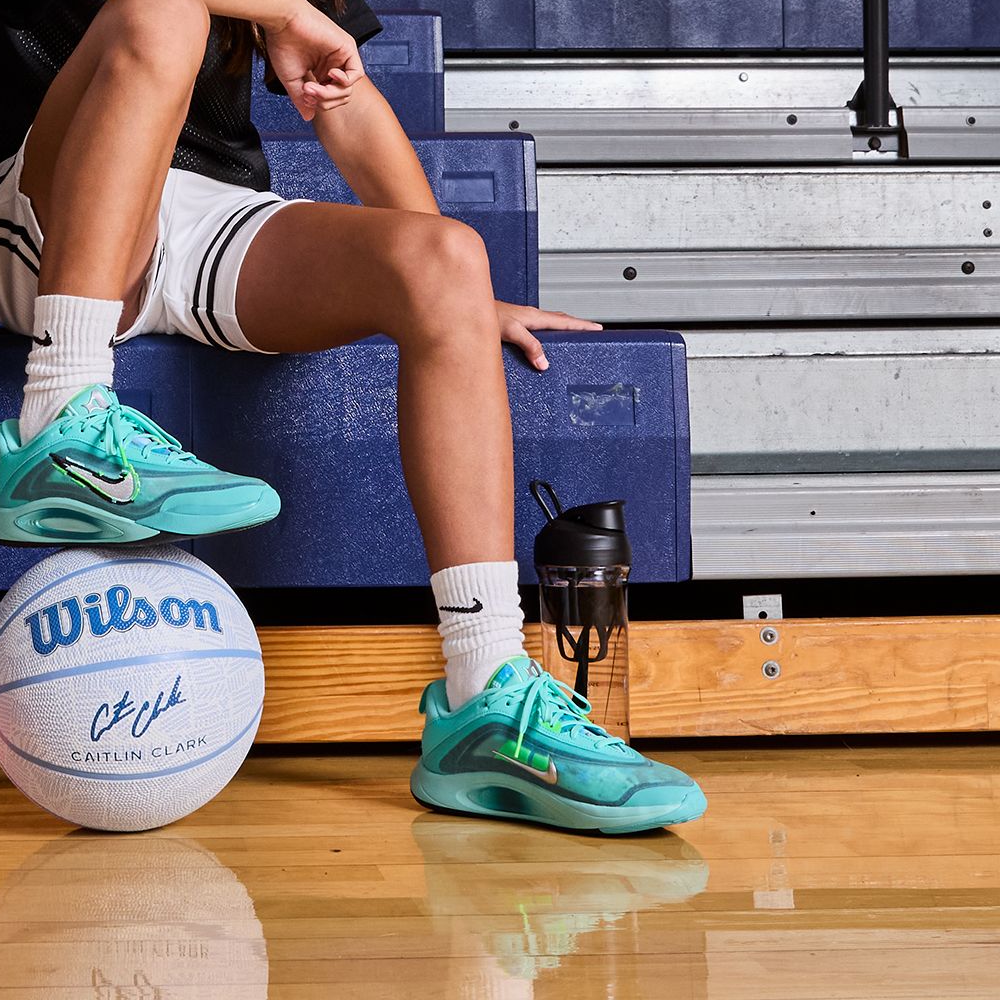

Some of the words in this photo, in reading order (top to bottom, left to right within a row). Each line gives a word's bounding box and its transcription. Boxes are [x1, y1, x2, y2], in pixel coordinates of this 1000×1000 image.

[24, 584, 223, 657] Wilson
[71, 750, 142, 763] CAITLIN
[151, 734, 207, 758] CLARK
